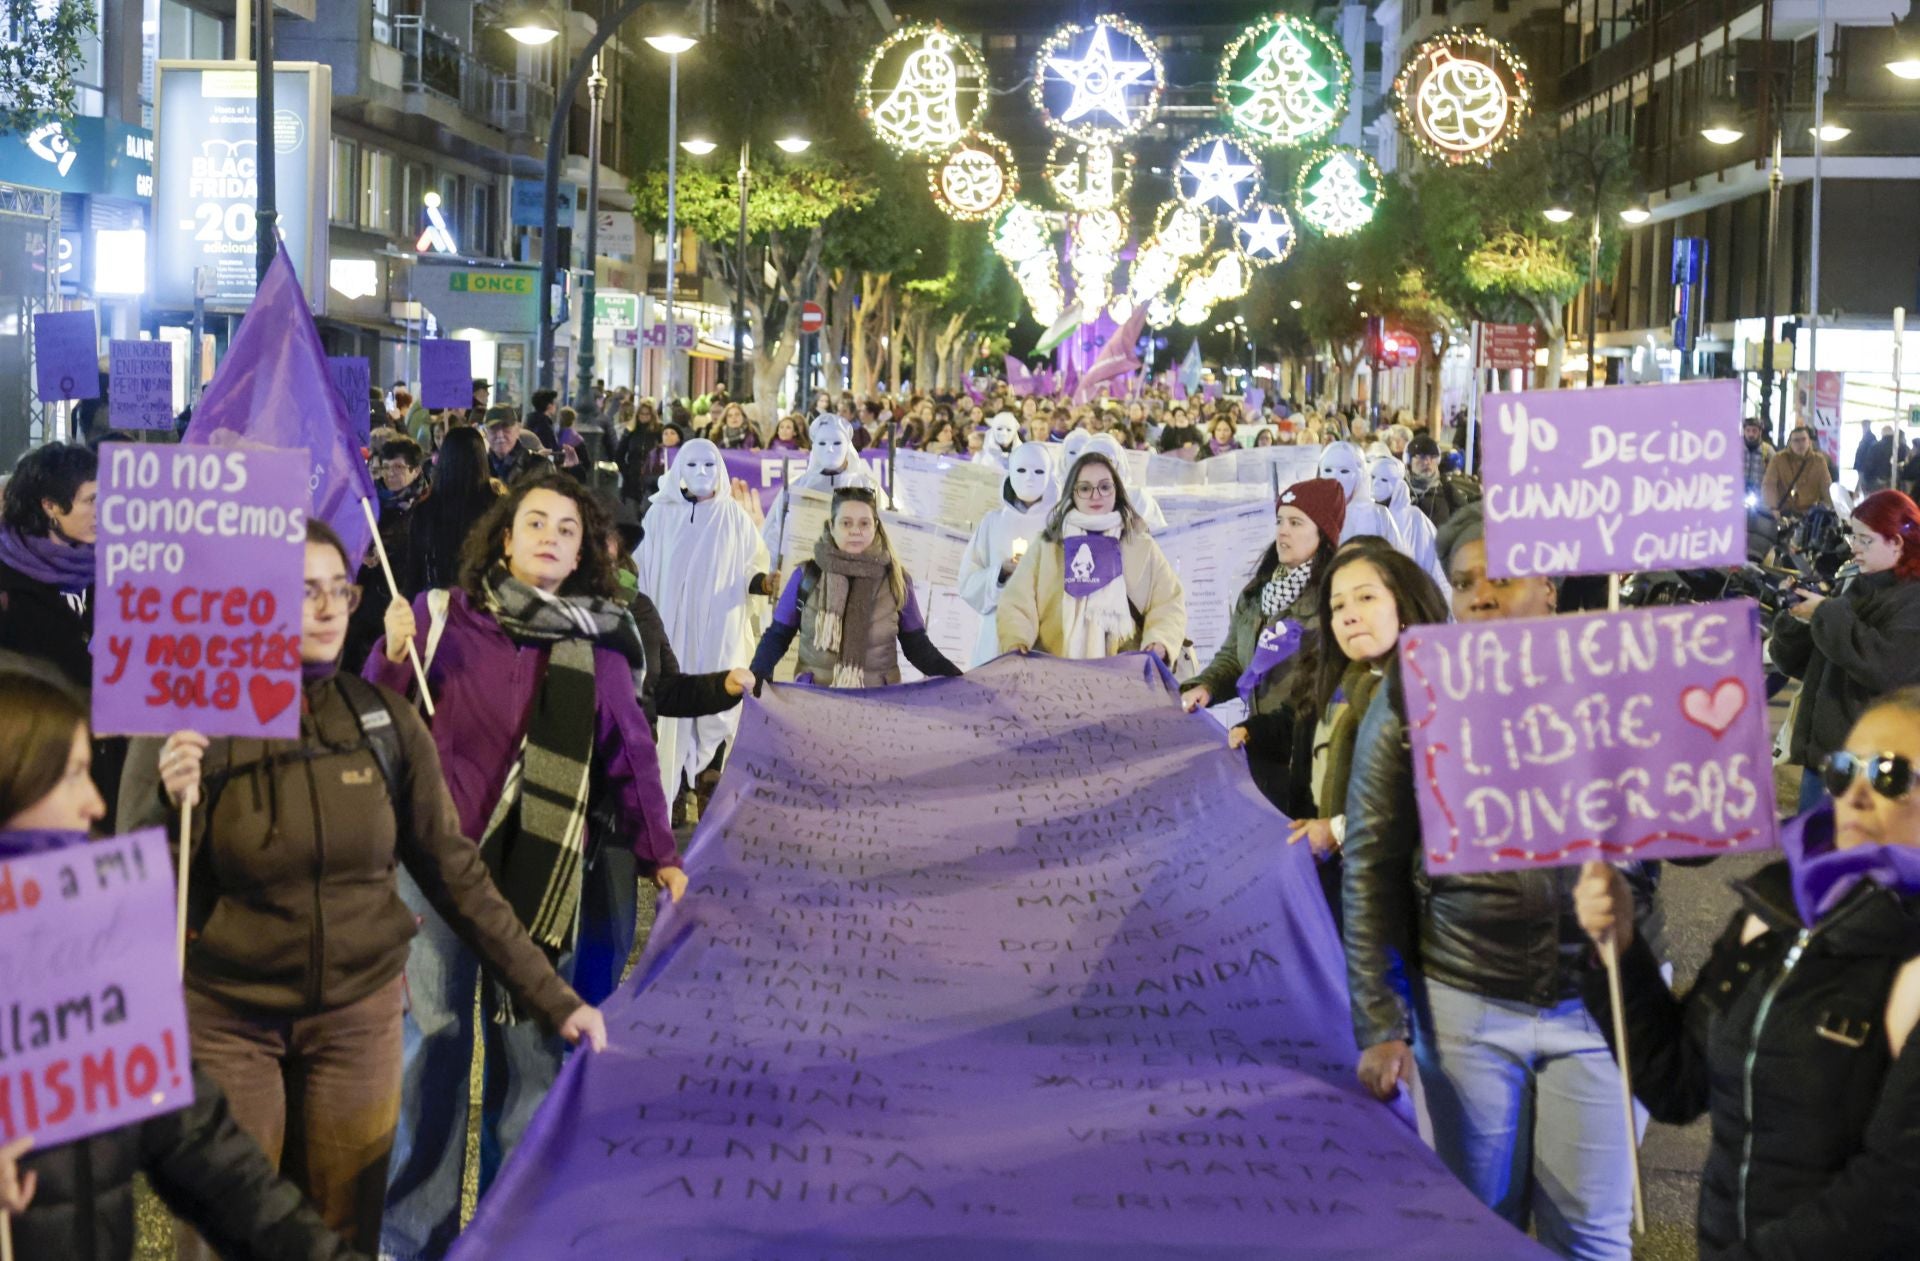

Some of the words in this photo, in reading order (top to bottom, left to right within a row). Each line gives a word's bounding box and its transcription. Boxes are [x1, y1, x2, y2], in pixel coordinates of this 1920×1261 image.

[189, 177, 258, 198] FRIDA
[192, 156, 257, 178] BLAC
[474, 276, 526, 290] ONCE
[1581, 420, 1728, 469] DECIDO
[111, 449, 160, 489] no
[171, 452, 247, 493] nos
[105, 540, 185, 587] pero
[1507, 539, 1581, 576] CON
[1597, 510, 1624, 556] Y
[116, 580, 162, 623] te
[170, 586, 276, 626] creo
[103, 634, 132, 686] y
[1434, 611, 1735, 702] VALIENTE
[145, 670, 242, 711] sola
[1459, 692, 1663, 776] LIBRE
[1463, 753, 1758, 848] DIVERSAS
[1029, 948, 1280, 997] YOLANDA
[0, 984, 127, 1060] lama
[598, 1135, 925, 1172] YOLANDA
